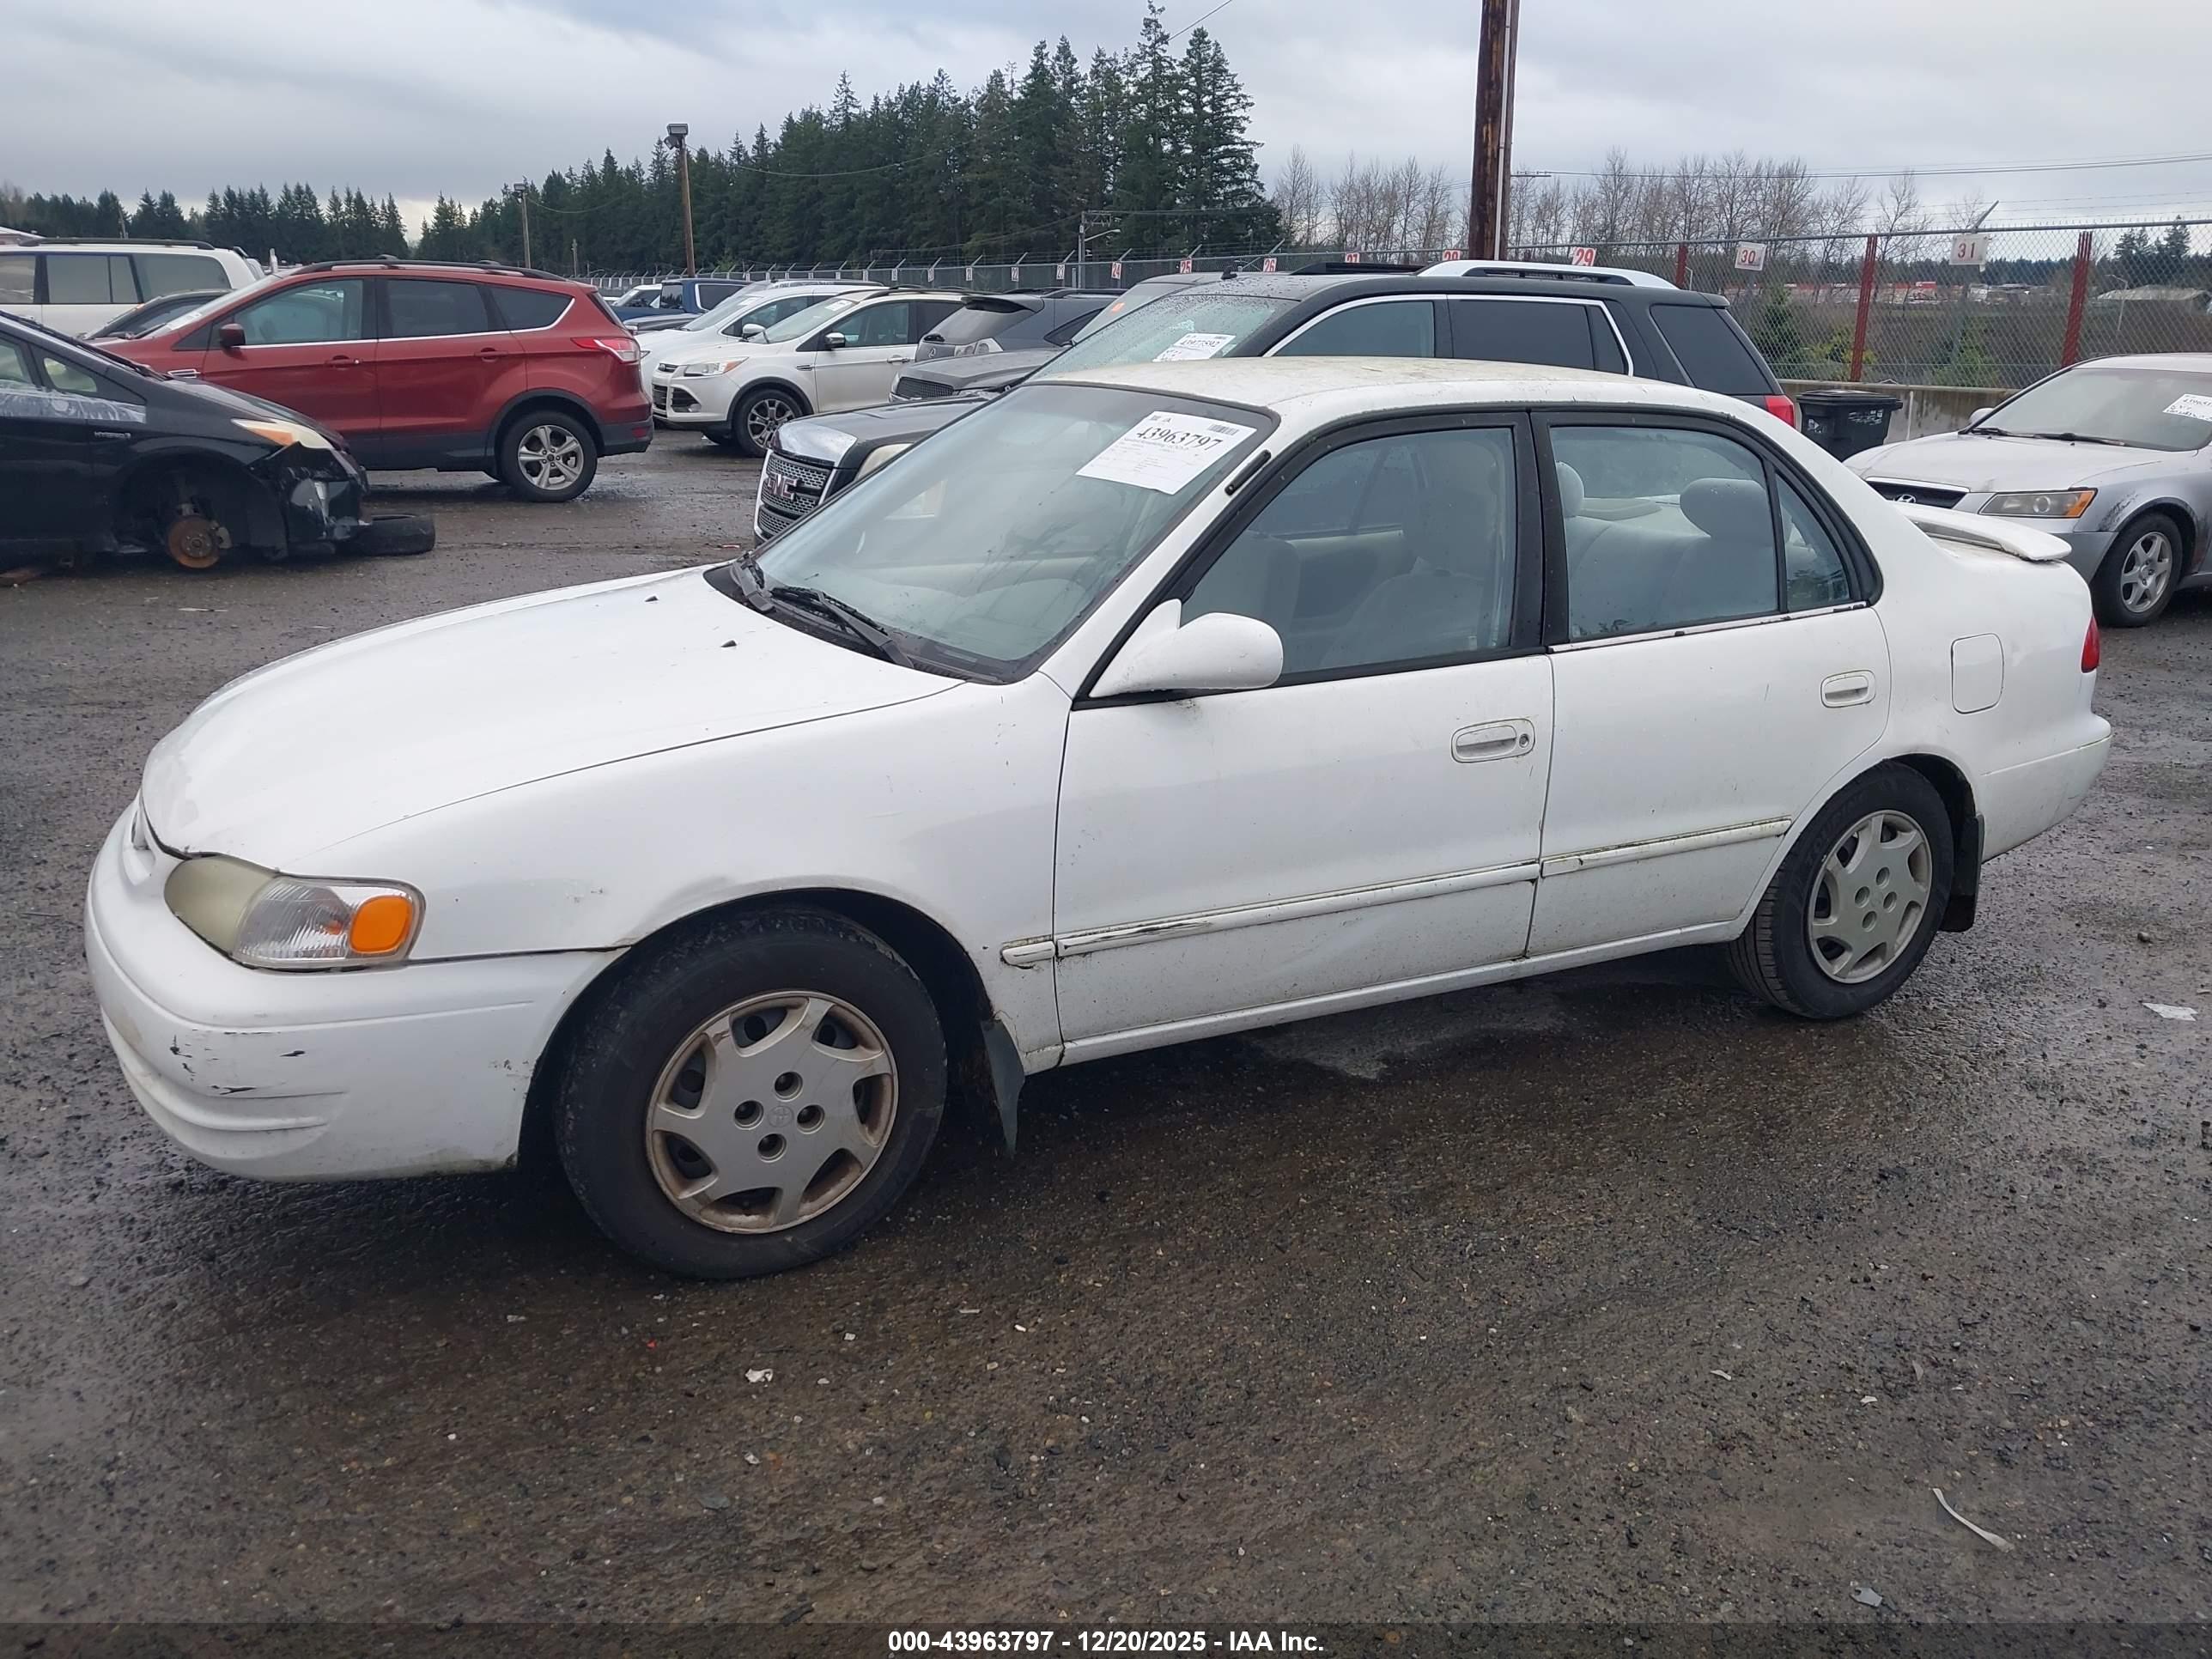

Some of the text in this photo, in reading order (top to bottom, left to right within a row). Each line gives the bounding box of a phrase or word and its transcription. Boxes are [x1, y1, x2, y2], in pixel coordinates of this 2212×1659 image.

[1576, 248, 1594, 266] 29
[1741, 250, 1756, 264] 30
[1958, 242, 1975, 258] 31
[1112, 263, 1121, 278] 24
[1182, 260, 1191, 274] 25
[1264, 258, 1275, 272] 26
[1136, 427, 1224, 451] 43963797
[767, 472, 797, 500] GMC
